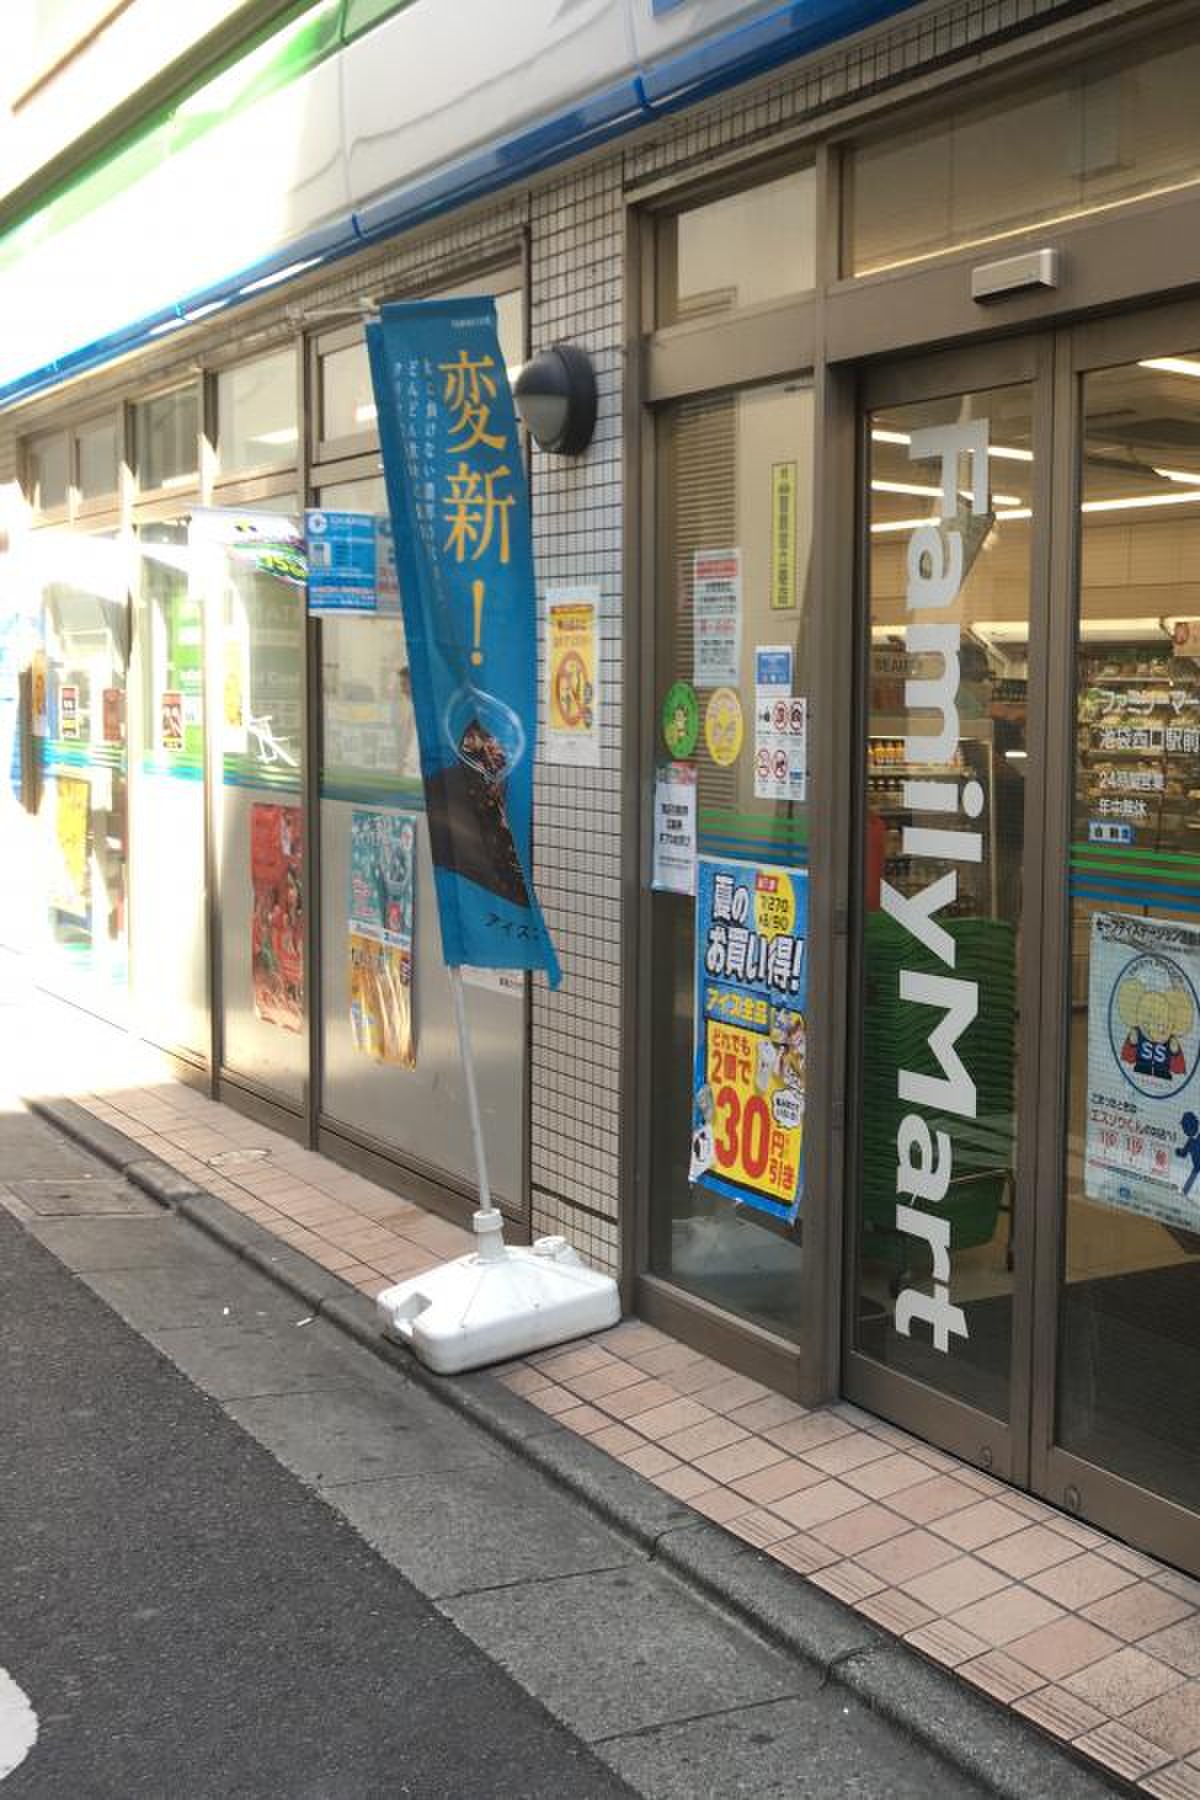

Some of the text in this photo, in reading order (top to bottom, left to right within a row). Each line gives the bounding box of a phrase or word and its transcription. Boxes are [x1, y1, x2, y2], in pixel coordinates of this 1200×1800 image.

[713, 874, 749, 924] 夏の
[880, 418, 990, 1354] FamilyMart
[1141, 1041, 1168, 1063] SS
